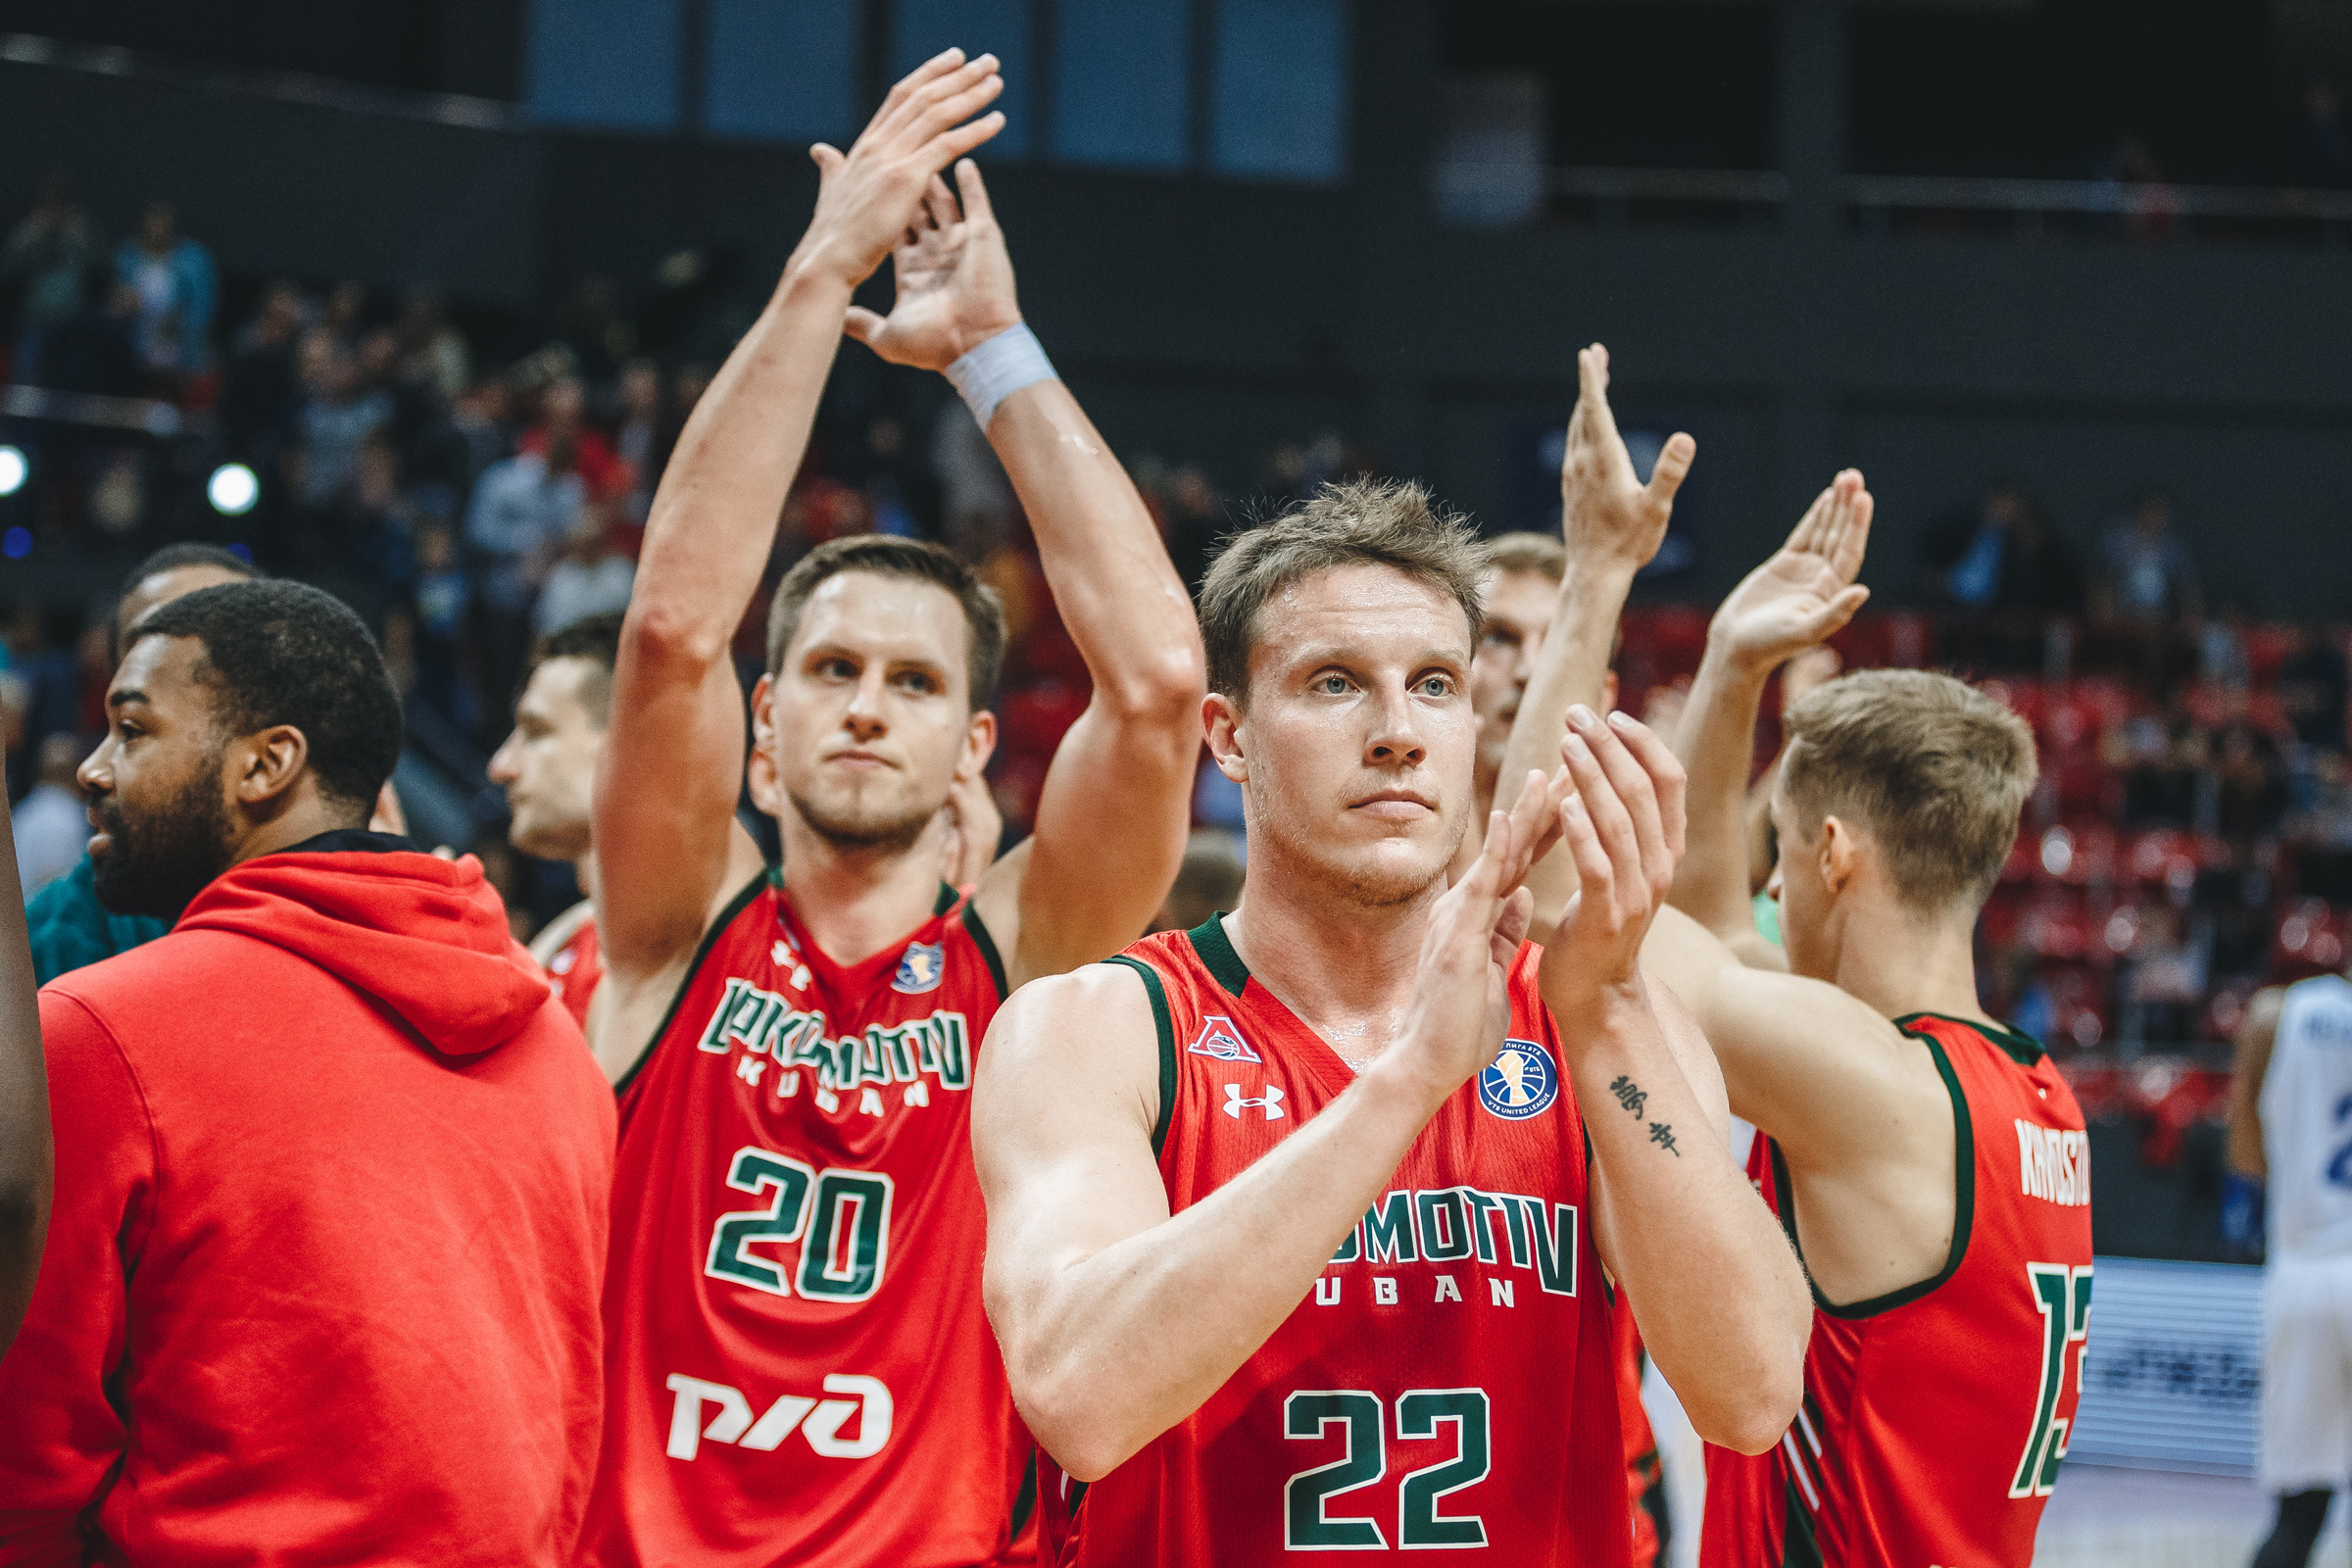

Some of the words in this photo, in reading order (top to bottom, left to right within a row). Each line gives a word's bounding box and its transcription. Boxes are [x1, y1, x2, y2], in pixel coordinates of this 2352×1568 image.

[1529, 1092, 1550, 1111] LEAGUE
[705, 1146, 894, 1302] 20
[1283, 1387, 1491, 1551] 22
